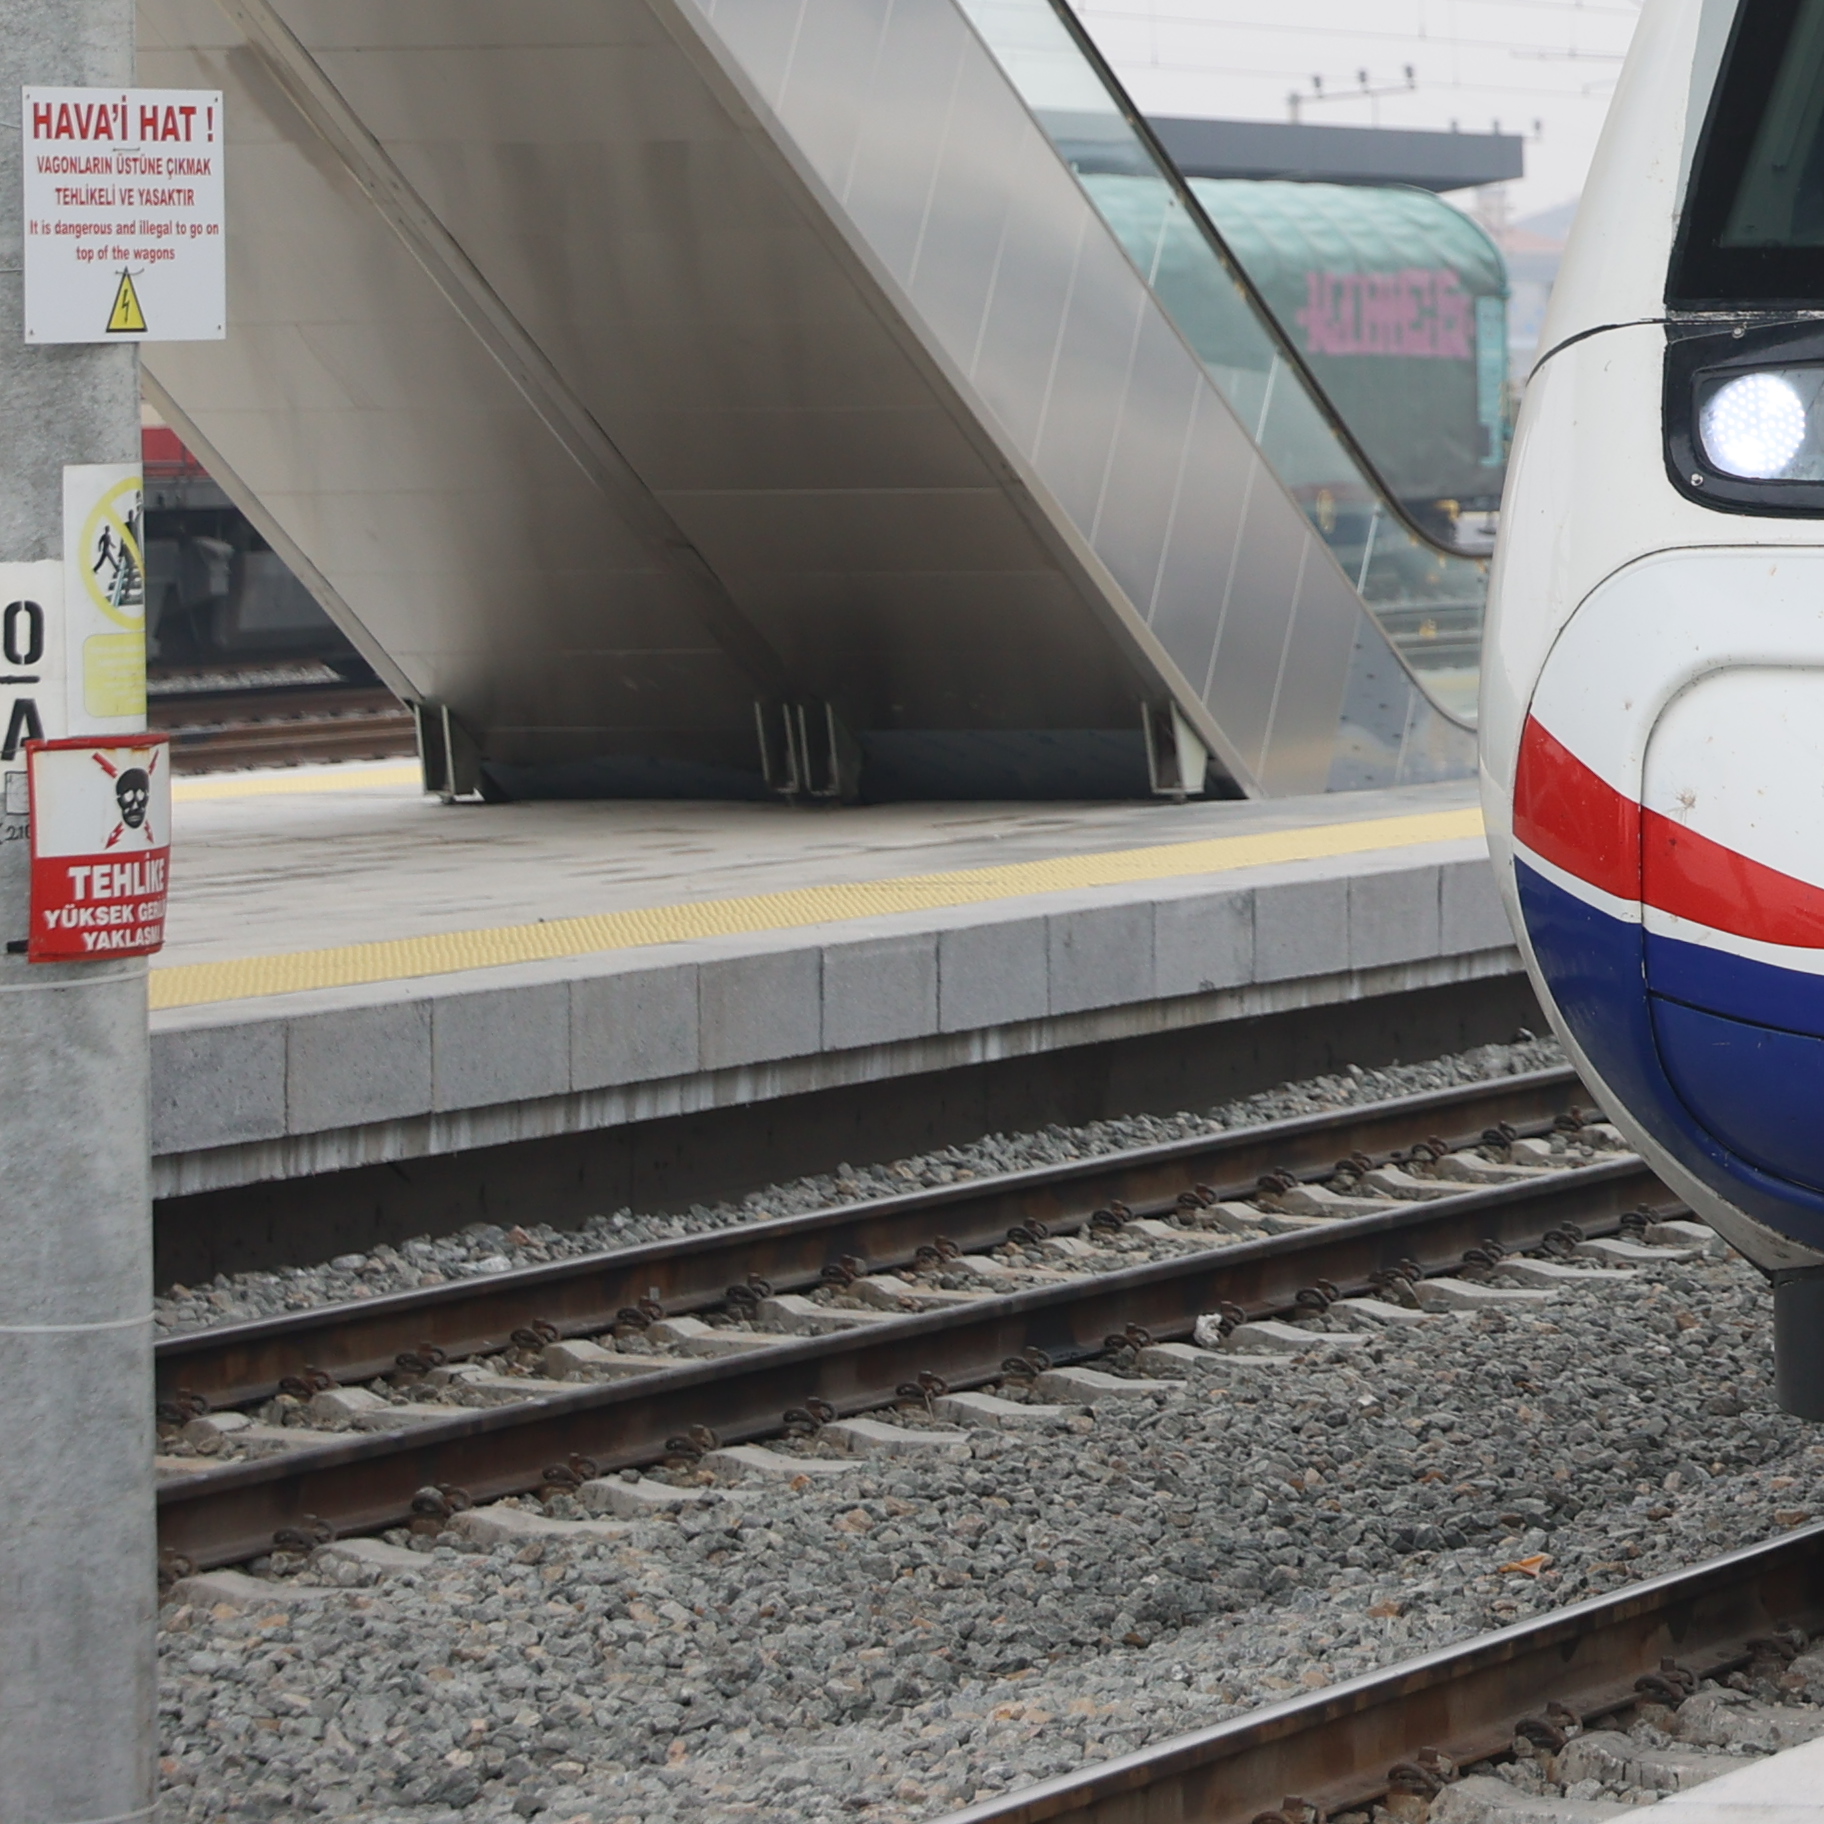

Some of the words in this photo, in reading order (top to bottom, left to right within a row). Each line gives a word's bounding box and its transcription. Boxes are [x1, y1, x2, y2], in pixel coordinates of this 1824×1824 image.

[139, 105, 197, 142] HAT
[37, 156, 113, 175] VAGONLARIN
[116, 152, 163, 176] ÜSTÜNE
[167, 157, 212, 180] ÇIKMAK
[55, 183, 116, 207] TEHLİKELİ
[119, 187, 134, 206] VE
[138, 187, 195, 207] YASAKTIR
[30, 220, 38, 235] It
[42, 219, 51, 235] is
[54, 220, 112, 238] dangerous
[116, 220, 136, 235] and
[139, 220, 173, 239] illegal
[176, 221, 187, 235] to
[190, 224, 203, 239] go
[206, 224, 219, 236] on
[76, 246, 94, 264] top
[98, 245, 109, 260] of
[112, 245, 130, 260] the
[133, 248, 175, 264] wagons
[68, 851, 165, 901] TEHLİKE
[43, 903, 134, 930] YÜKSEK
